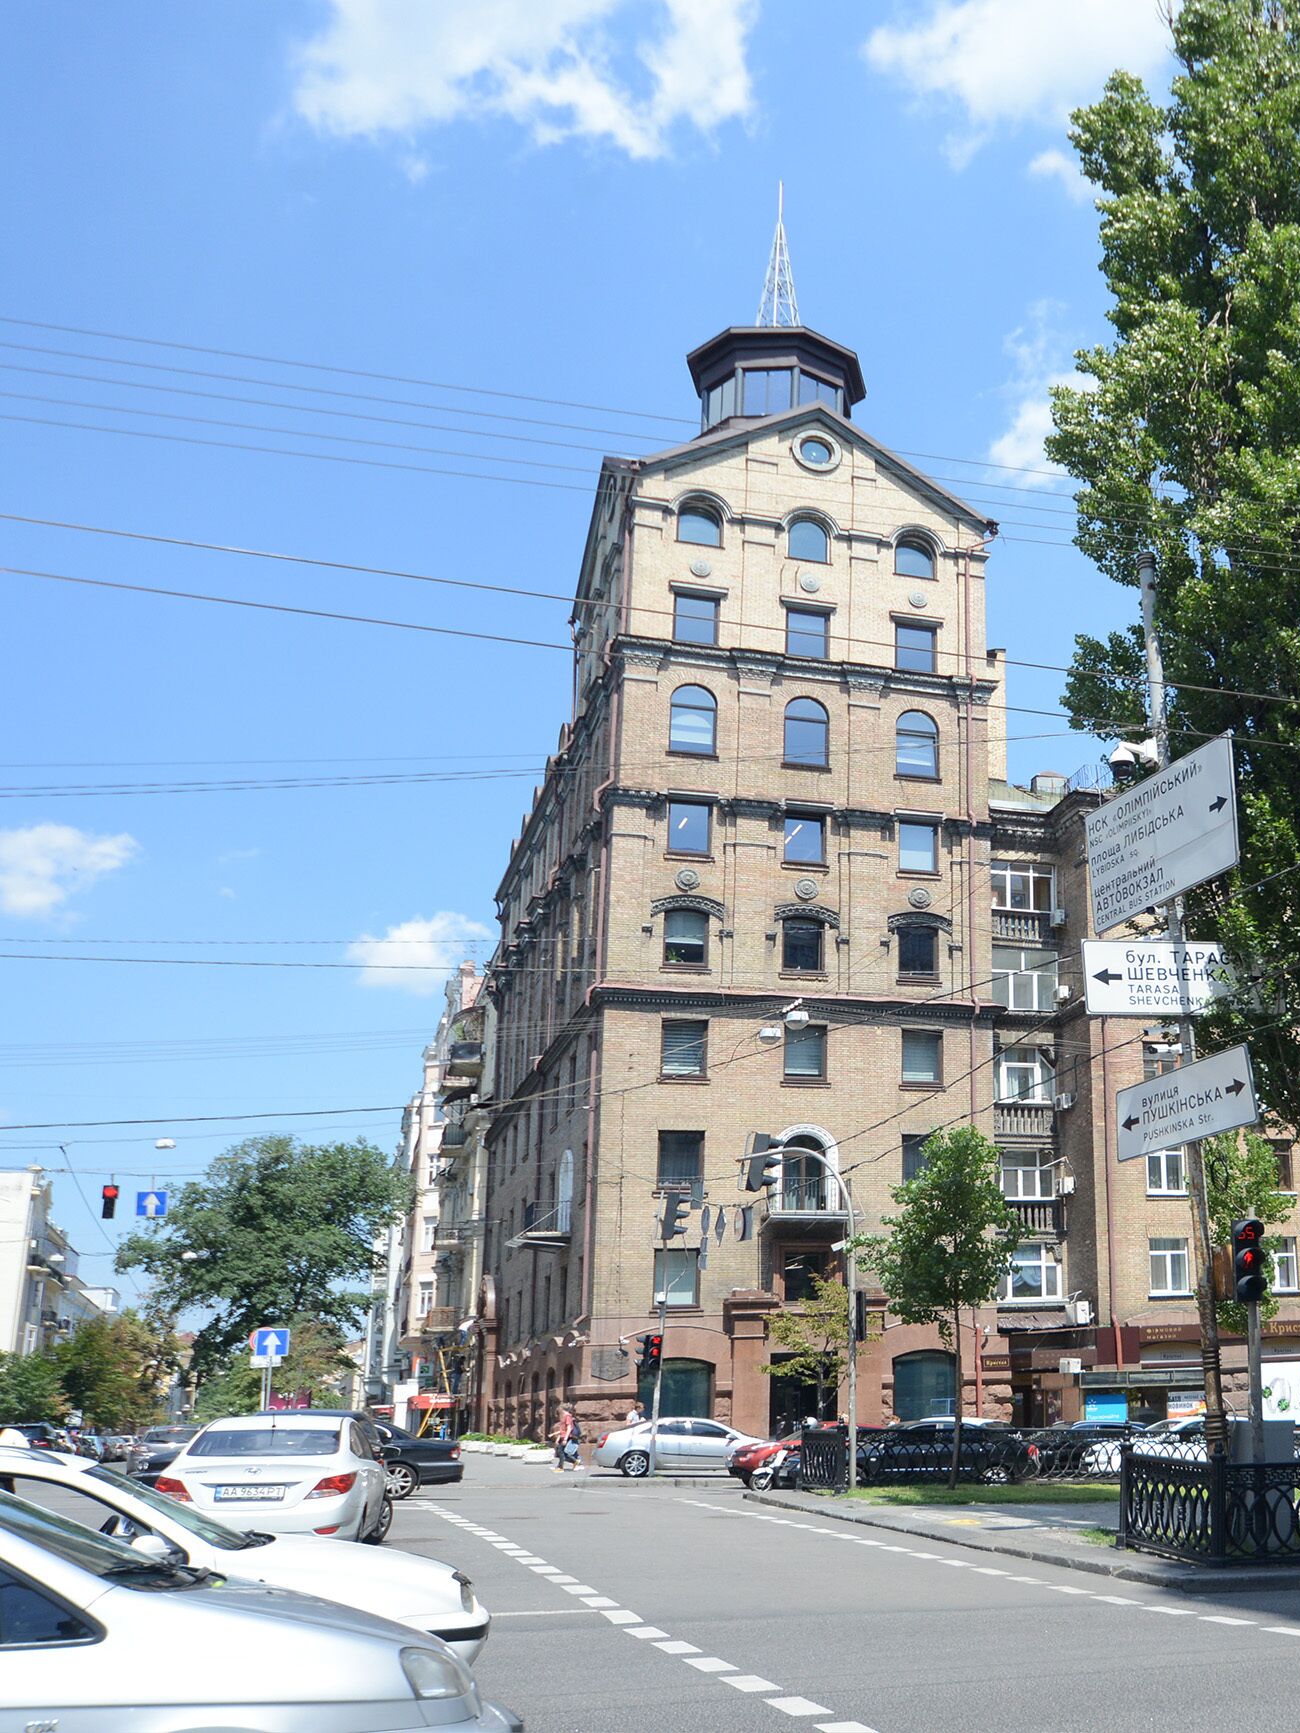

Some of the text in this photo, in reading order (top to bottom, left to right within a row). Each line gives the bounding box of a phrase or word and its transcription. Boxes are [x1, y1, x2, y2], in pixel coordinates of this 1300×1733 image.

[1088, 815, 1109, 836] НСК
[1091, 805, 1185, 867] площа ЛИБІДСЬКА
[1089, 834, 1103, 849] NSC
[1092, 855, 1126, 879] LYBIDSKA
[1094, 857, 1156, 899] центральний
[1096, 867, 1165, 914] АВТОВОКЗАЛ
[1096, 878, 1176, 926] CENTRAL BUS STATION
[1125, 949, 1240, 967] бул. ТАРАС
[1127, 967, 1230, 982] ШЕВЧЕНКА
[1128, 984, 1181, 994] TARASA
[1129, 995, 1210, 1006] SHEVCHENK
[1142, 1086, 1179, 1108] вулиця
[1142, 1086, 1223, 1126] ПУШКІНСЬКА
[1143, 1113, 1215, 1142] PUSHKINSKA Str.
